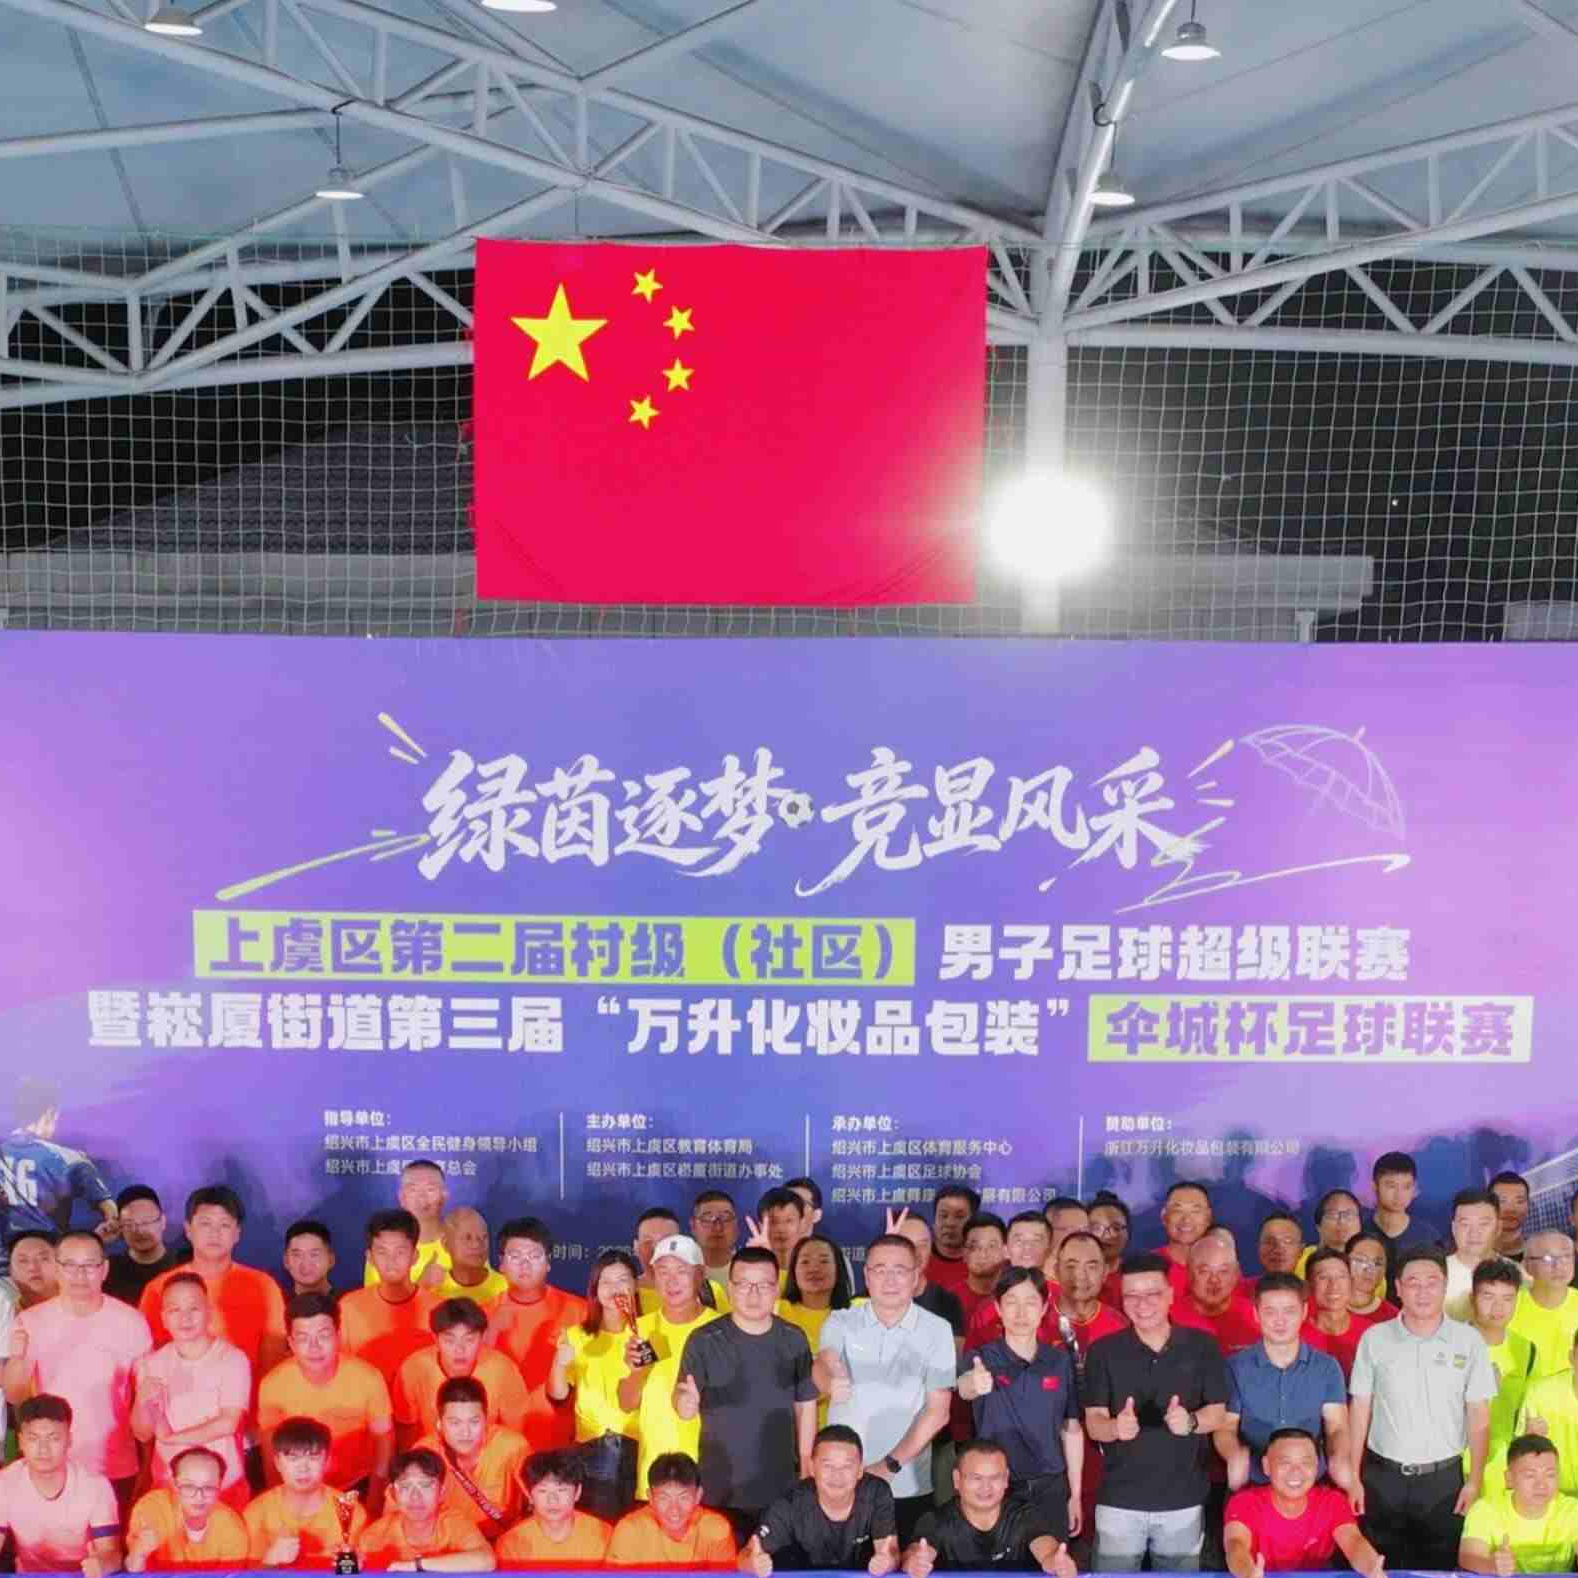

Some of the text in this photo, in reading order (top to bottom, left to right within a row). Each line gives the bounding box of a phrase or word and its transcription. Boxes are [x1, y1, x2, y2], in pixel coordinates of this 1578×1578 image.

[417, 746, 1179, 897] 绿茵逐梦 竞显风采
[938, 922, 1411, 982] 男子足球超级联赛
[1105, 1000, 1516, 1056] 伞城杯足球联赛
